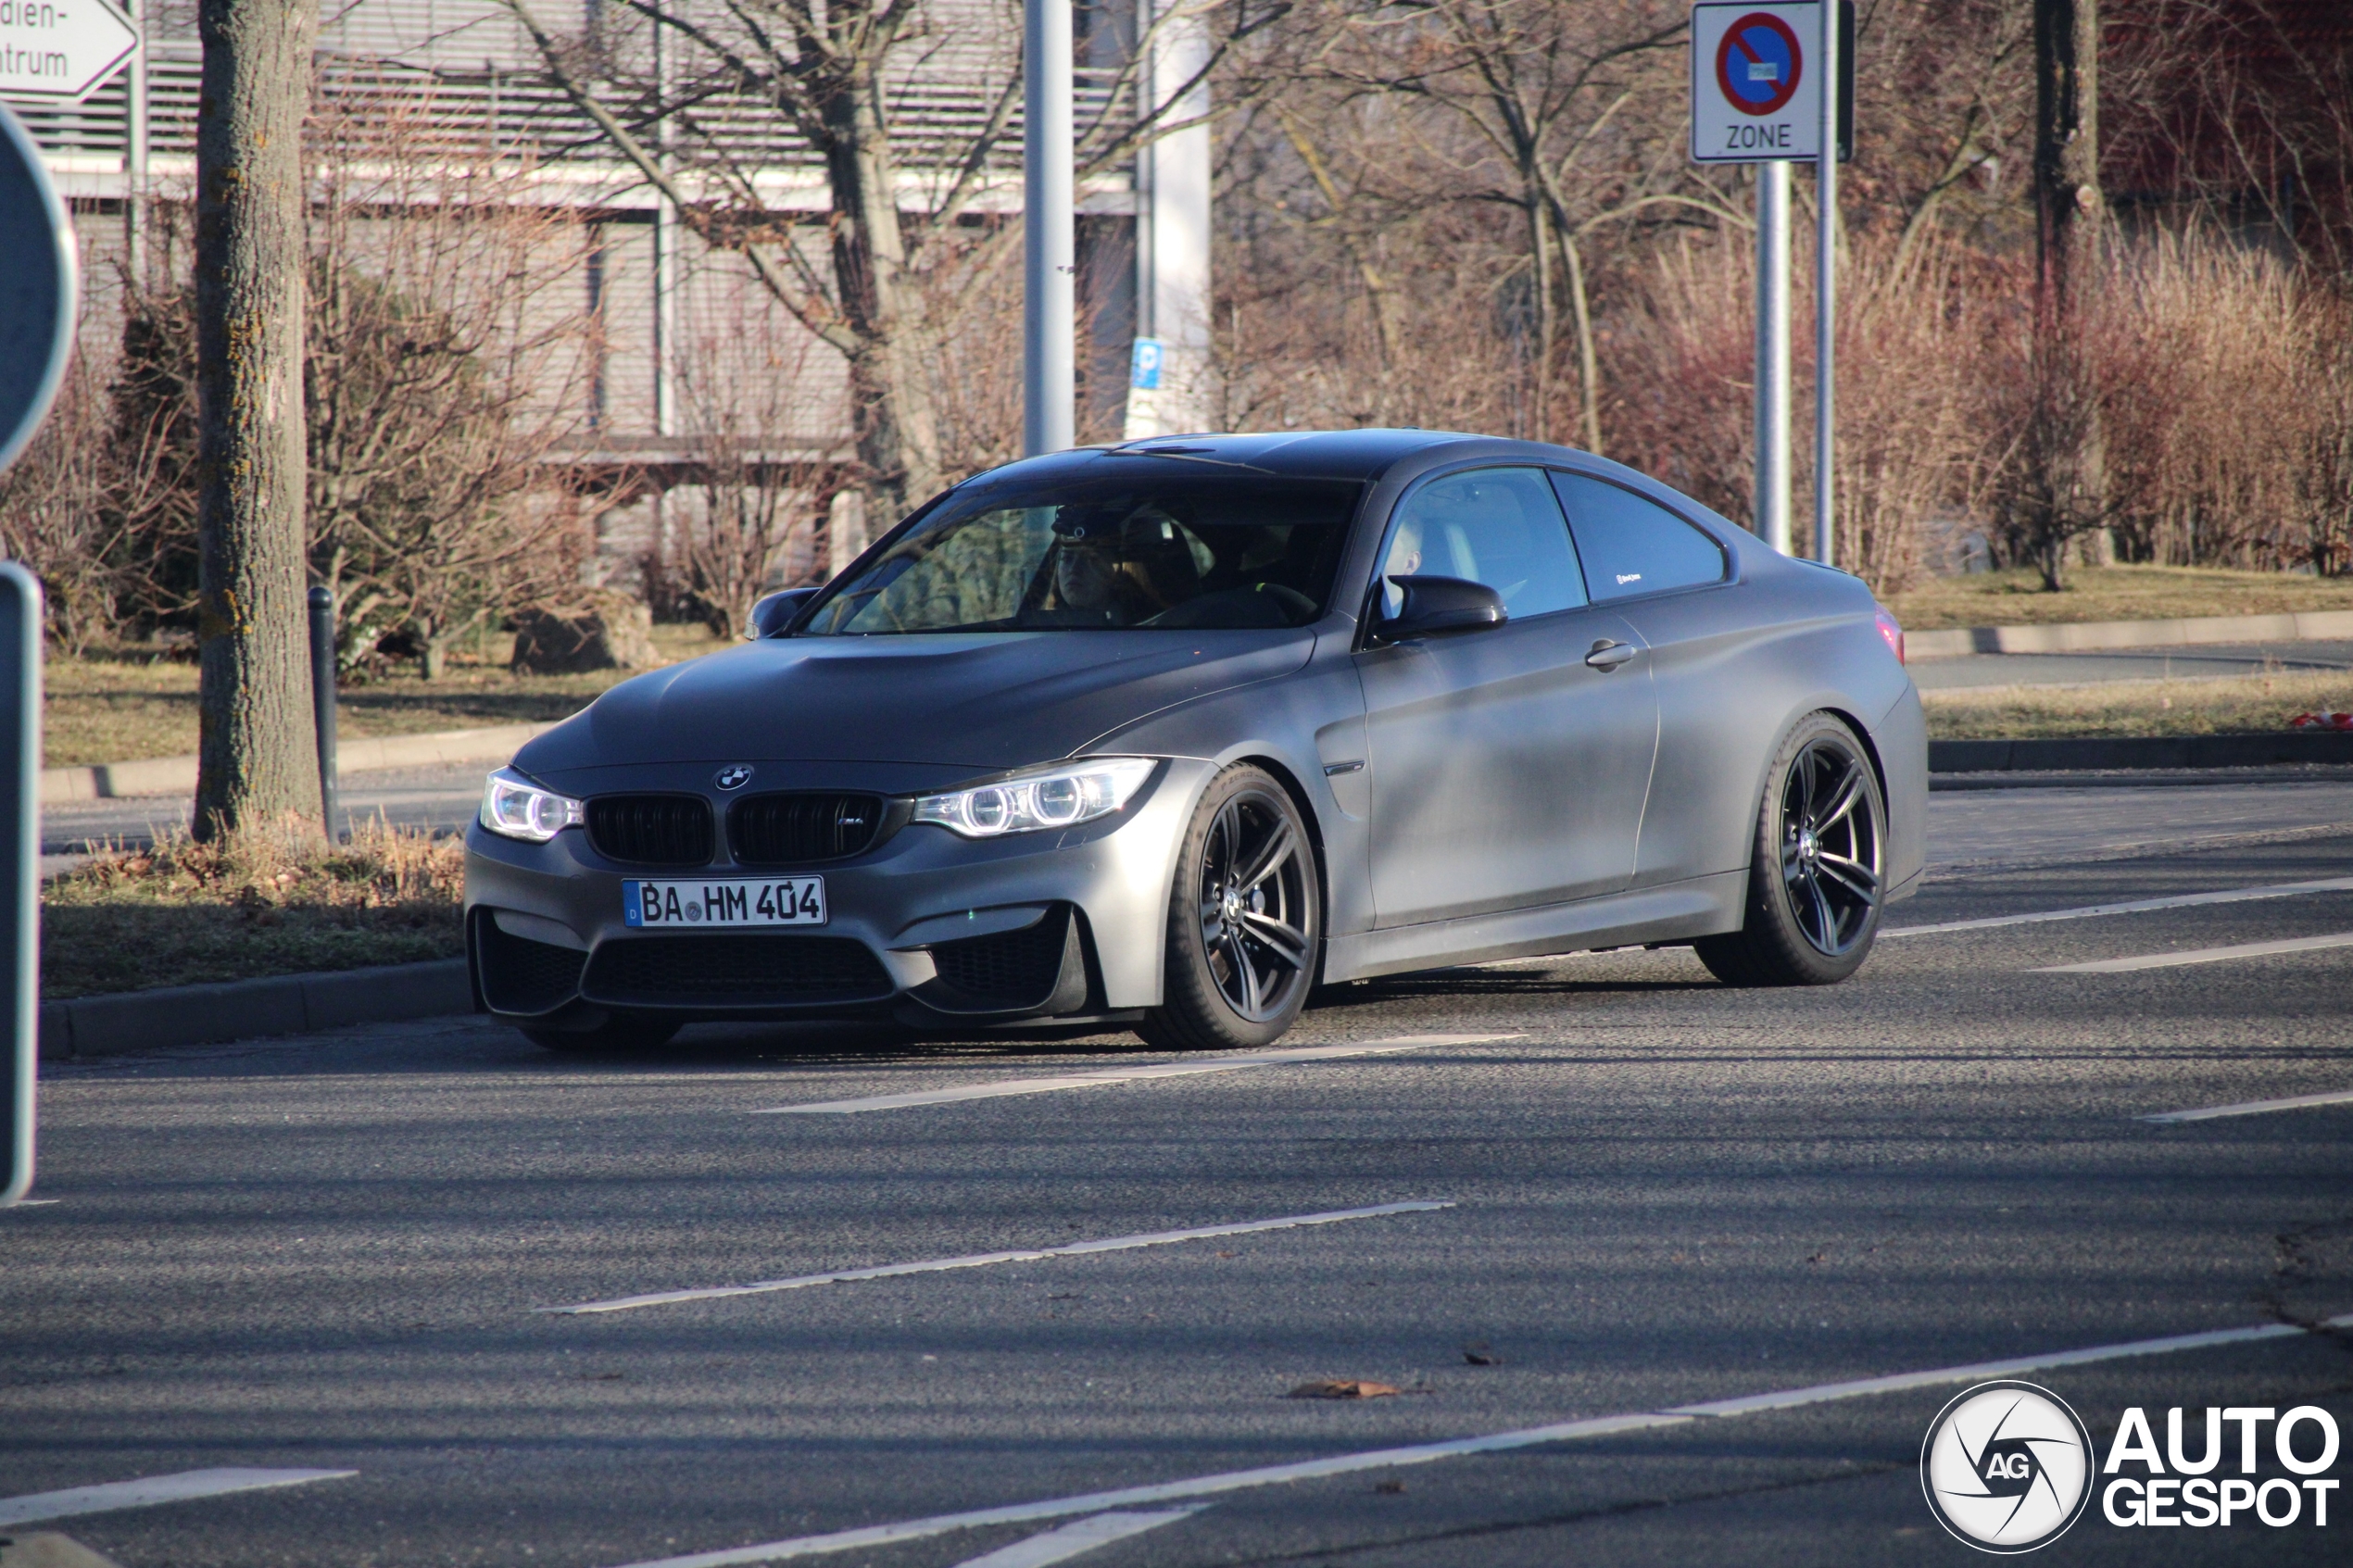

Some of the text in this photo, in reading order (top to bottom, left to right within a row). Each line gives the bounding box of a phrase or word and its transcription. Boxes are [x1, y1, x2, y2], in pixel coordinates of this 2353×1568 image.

[0, 0, 68, 28] dien-
[0, 43, 67, 77] trum
[1727, 124, 1791, 148] ZONE
[630, 909, 637, 920] D
[641, 883, 819, 922] BA HM 404
